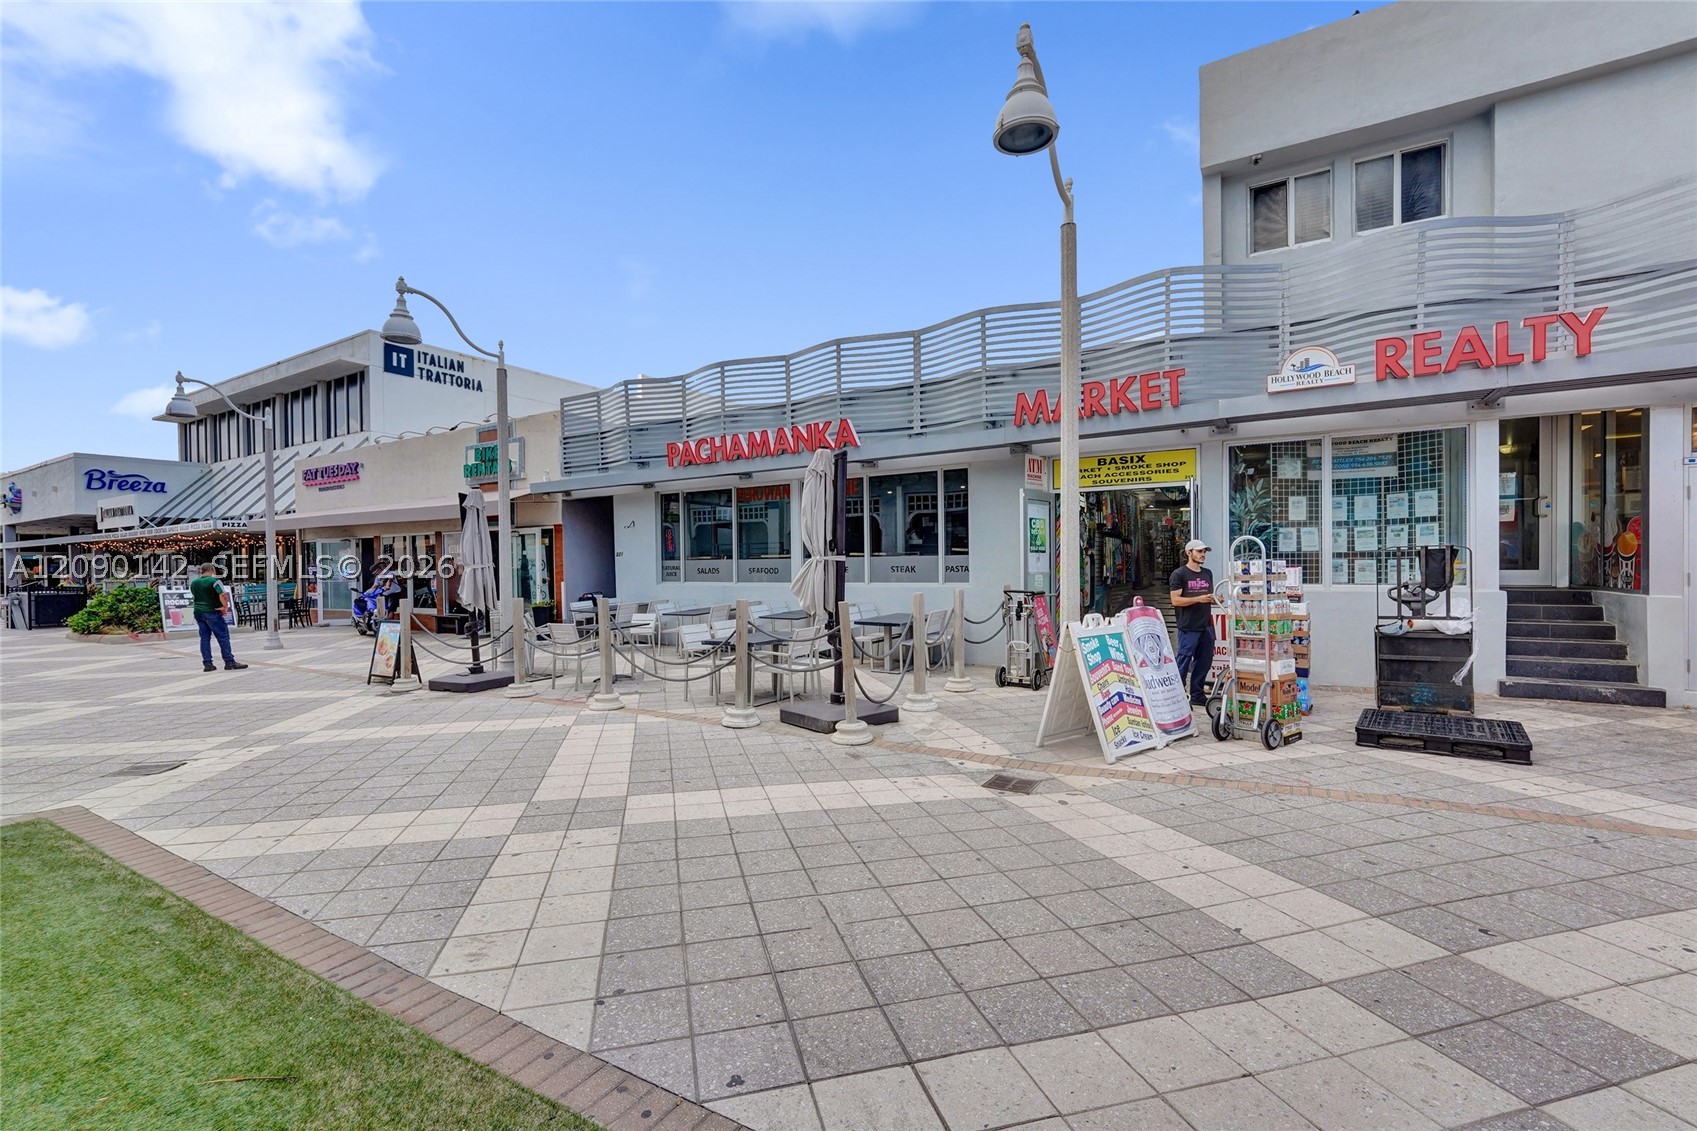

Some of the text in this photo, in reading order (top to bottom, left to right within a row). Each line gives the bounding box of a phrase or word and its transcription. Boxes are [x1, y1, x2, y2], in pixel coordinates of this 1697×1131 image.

[1375, 306, 1608, 381] REALTY
[392, 351, 407, 368] IT
[417, 350, 465, 373] ITALIAN
[418, 367, 483, 392] TRATTORIA
[1270, 367, 1352, 384] HOLLYWOOD BEACH
[1296, 378, 1324, 386] REALTY
[666, 418, 861, 468] PACHAMANKA
[1027, 457, 1043, 474] ATM
[1097, 454, 1146, 466] BASIX
[1115, 463, 1152, 471] SMOKE
[1156, 460, 1187, 468] SHOP
[317, 461, 360, 479] TUESDAY
[1104, 467, 1180, 478] ACCESSORIES
[84, 468, 168, 494] Breeza
[1092, 476, 1153, 485] SOUVENIRS
[736, 483, 792, 503] PERUVIAN
[697, 567, 720, 575] SALADS
[748, 567, 779, 575] SEAFOOD
[890, 565, 917, 573] STEAK
[945, 565, 970, 573] PASTA
[1081, 637, 1100, 655] Smoke
[1105, 634, 1119, 648] Beer
[1086, 651, 1102, 666] Shop
[1108, 646, 1126, 662] Wine
[1111, 724, 1121, 737] Ice
[1132, 729, 1154, 741] Ice Cream
[1113, 735, 1127, 750] Snacks
